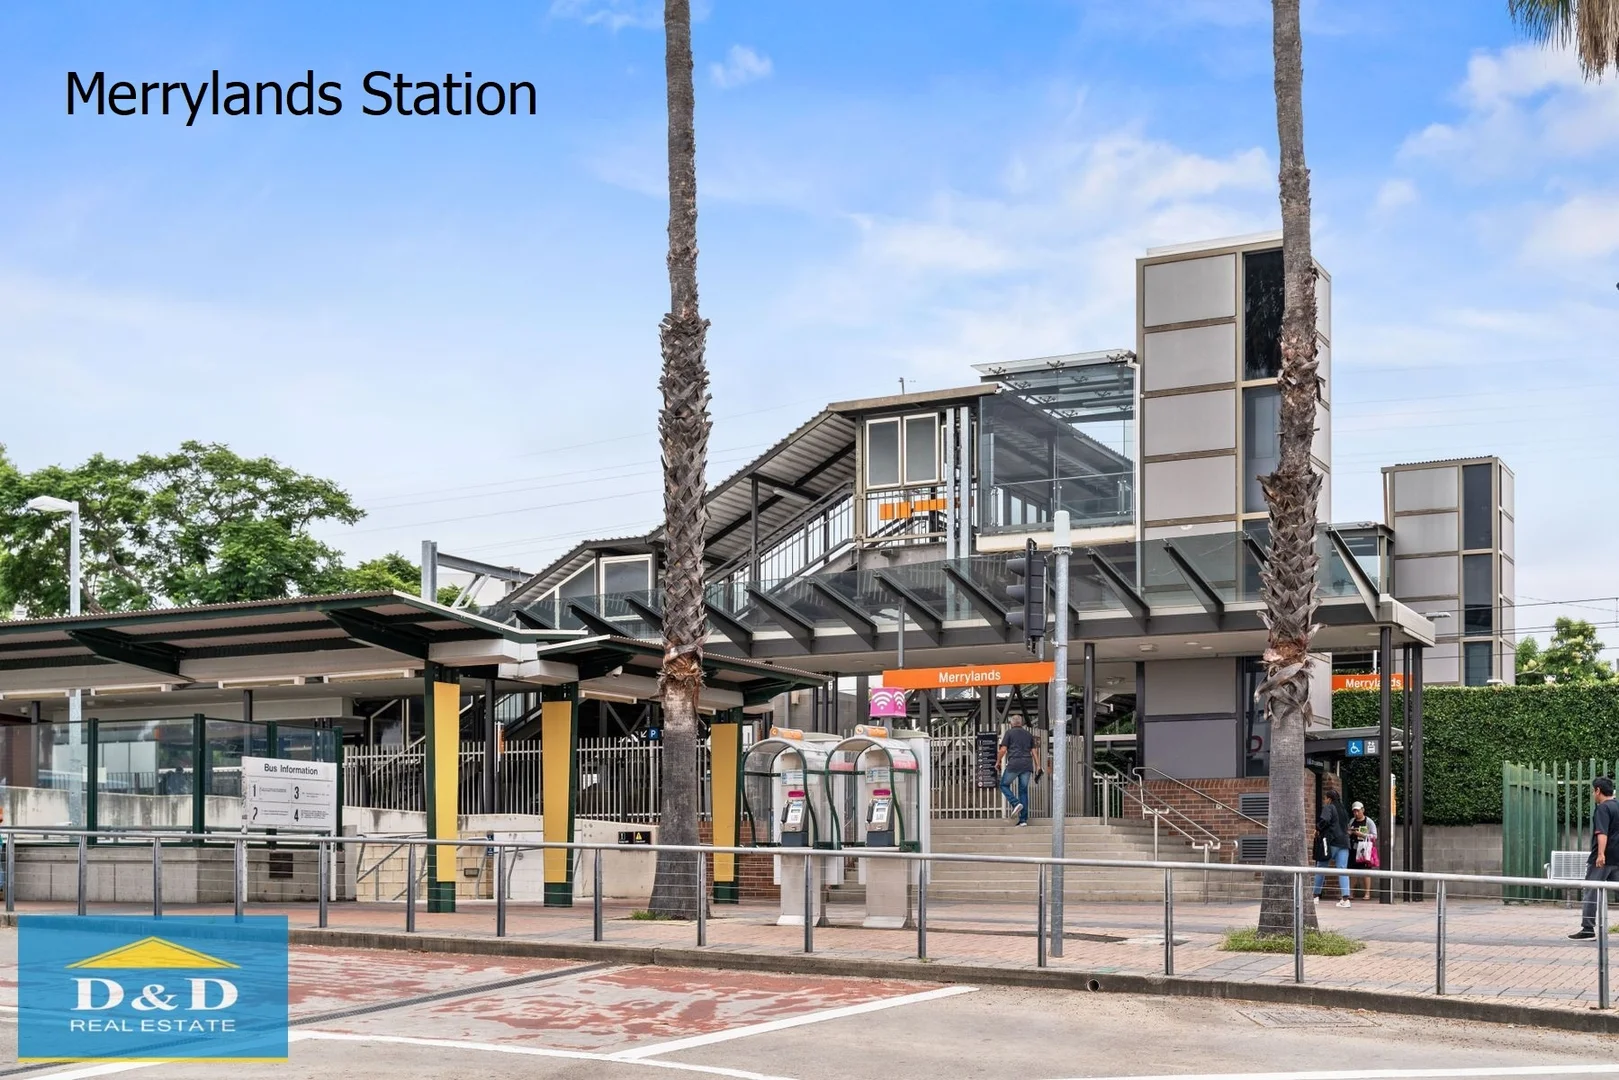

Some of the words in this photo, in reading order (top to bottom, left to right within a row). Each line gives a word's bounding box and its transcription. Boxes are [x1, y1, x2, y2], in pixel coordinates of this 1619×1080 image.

[939, 670, 1001, 684] Merrylands
[1345, 678, 1401, 688] Merrylads
[264, 763, 278, 772] Bus
[280, 764, 319, 775] Information
[252, 784, 256, 797] 1
[294, 786, 300, 800] 3
[294, 809, 299, 822] 4
